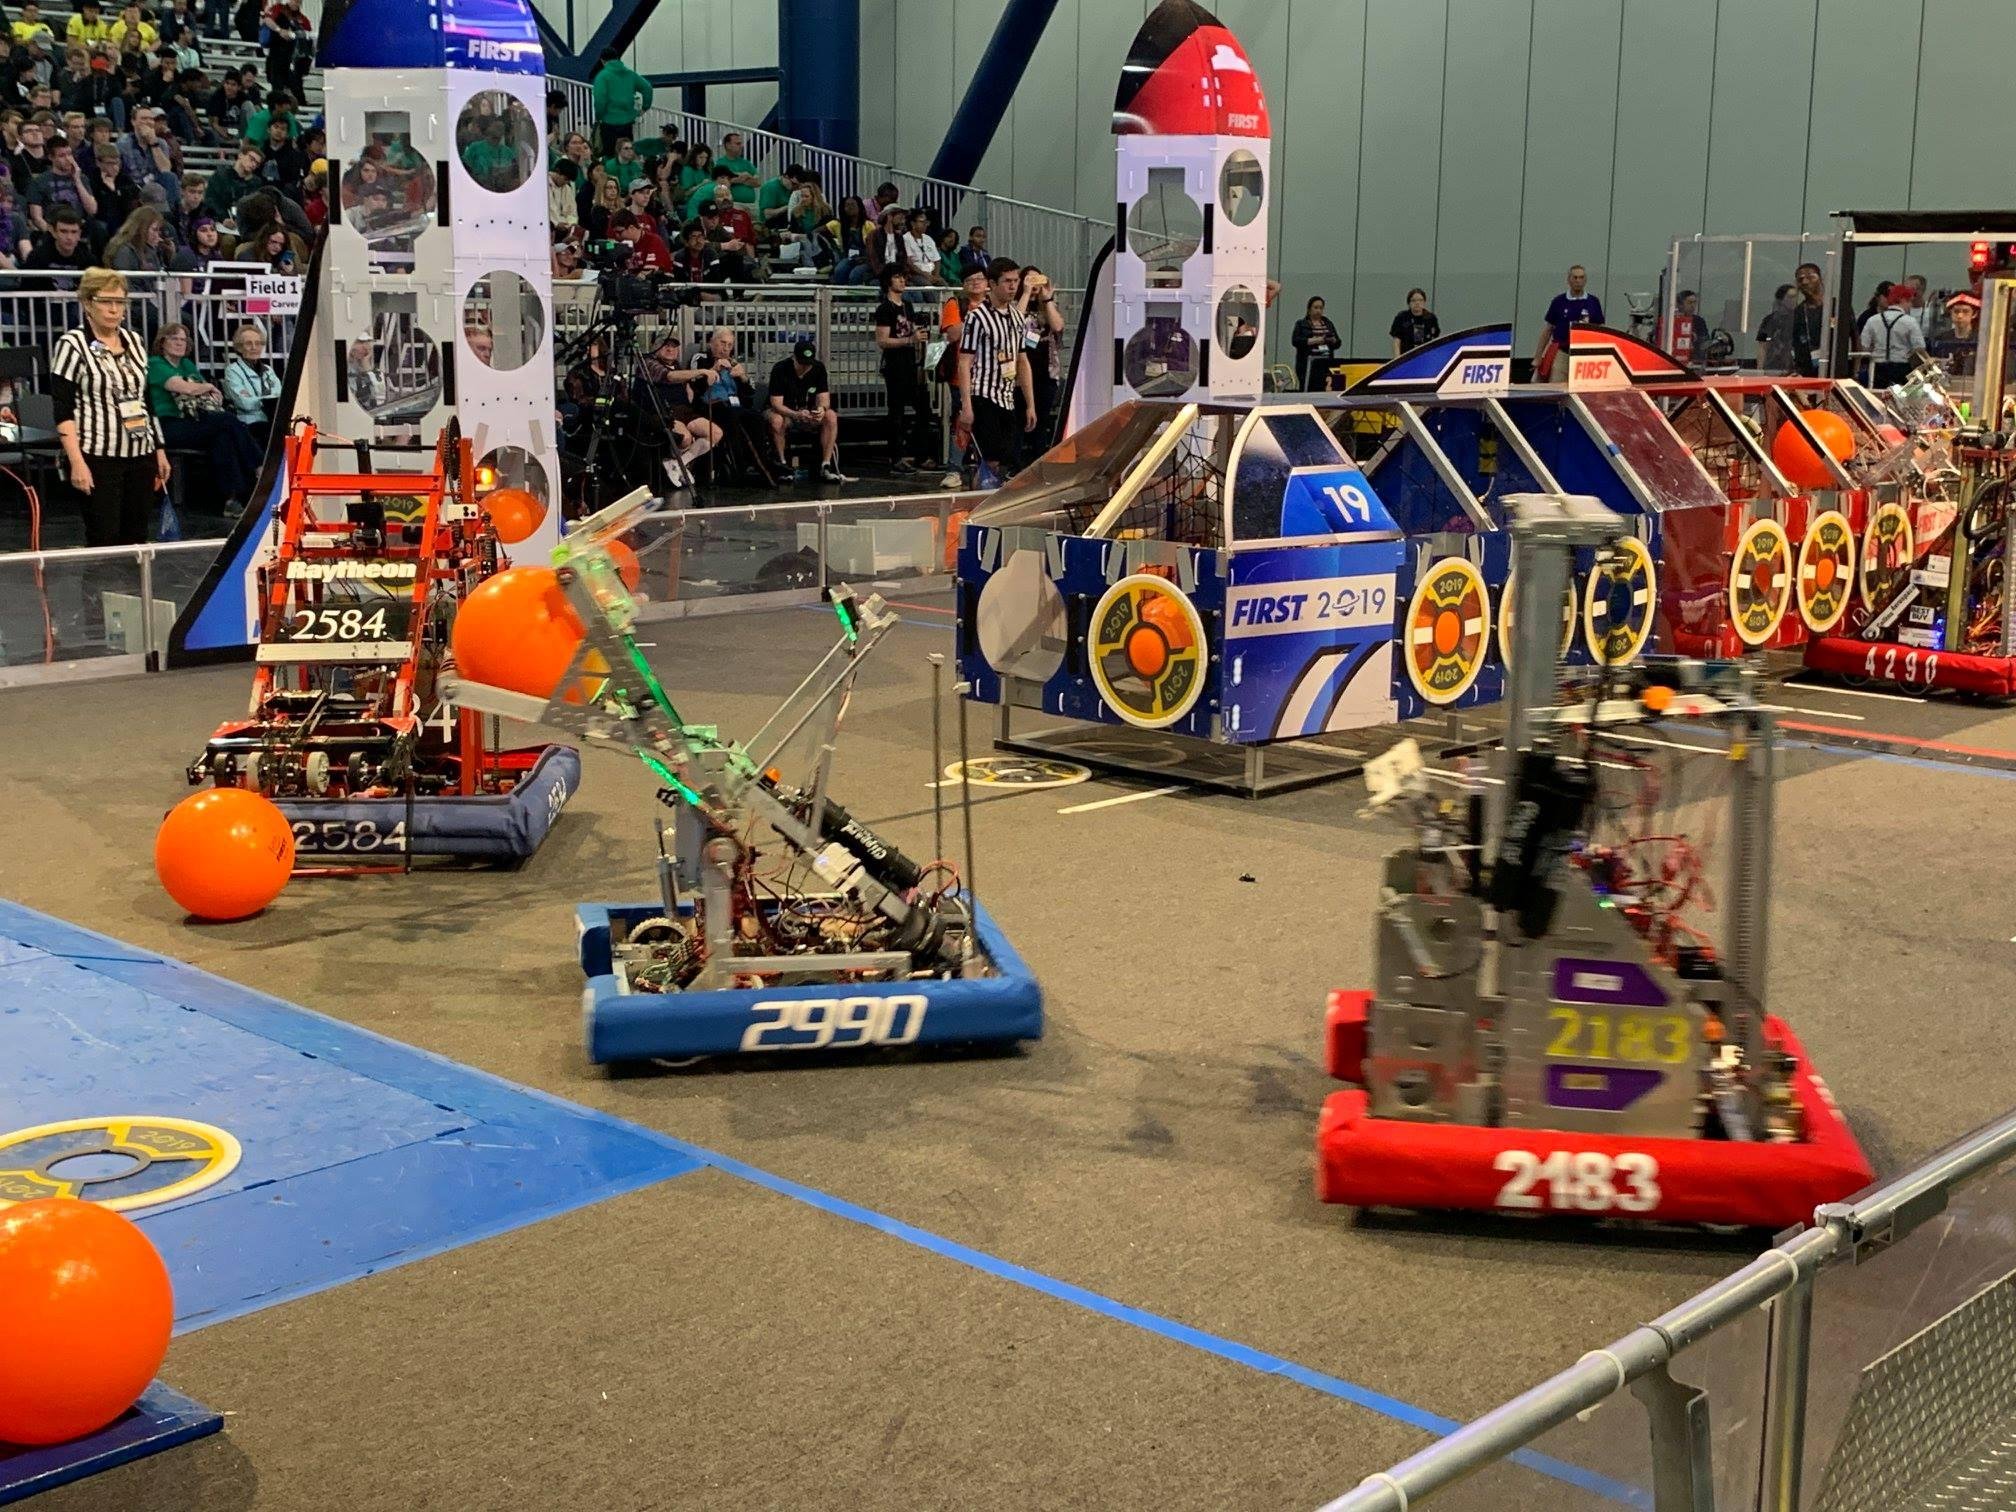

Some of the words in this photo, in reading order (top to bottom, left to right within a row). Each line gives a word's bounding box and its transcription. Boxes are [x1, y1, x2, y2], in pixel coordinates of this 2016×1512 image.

[468, 39, 521, 62] FIRST
[1228, 112, 1259, 130] FIRST
[250, 281, 286, 294] Field
[290, 281, 298, 294] 1
[271, 300, 299, 308] Carver
[1462, 364, 1504, 384] FIRST
[1574, 361, 1611, 380] FIRST
[1322, 484, 1371, 523] 19
[286, 561, 417, 583] Raytheon
[1439, 578, 1464, 594] 2019
[1232, 594, 1308, 627] FIRST
[1316, 587, 1386, 619] 2019
[1911, 606, 1930, 615] BEST
[1912, 613, 1928, 621] BUY
[290, 607, 387, 640] 2584
[1105, 602, 1130, 639] 2019
[1434, 668, 1459, 684] 2019
[1864, 645, 1939, 685] 4290
[1164, 665, 1189, 702] 2019
[292, 820, 406, 851] 2584
[739, 994, 928, 1051] 2990
[1545, 1007, 1692, 1064] 2183
[140, 1130, 196, 1149] 2019
[1493, 1150, 1663, 1212] 2183
